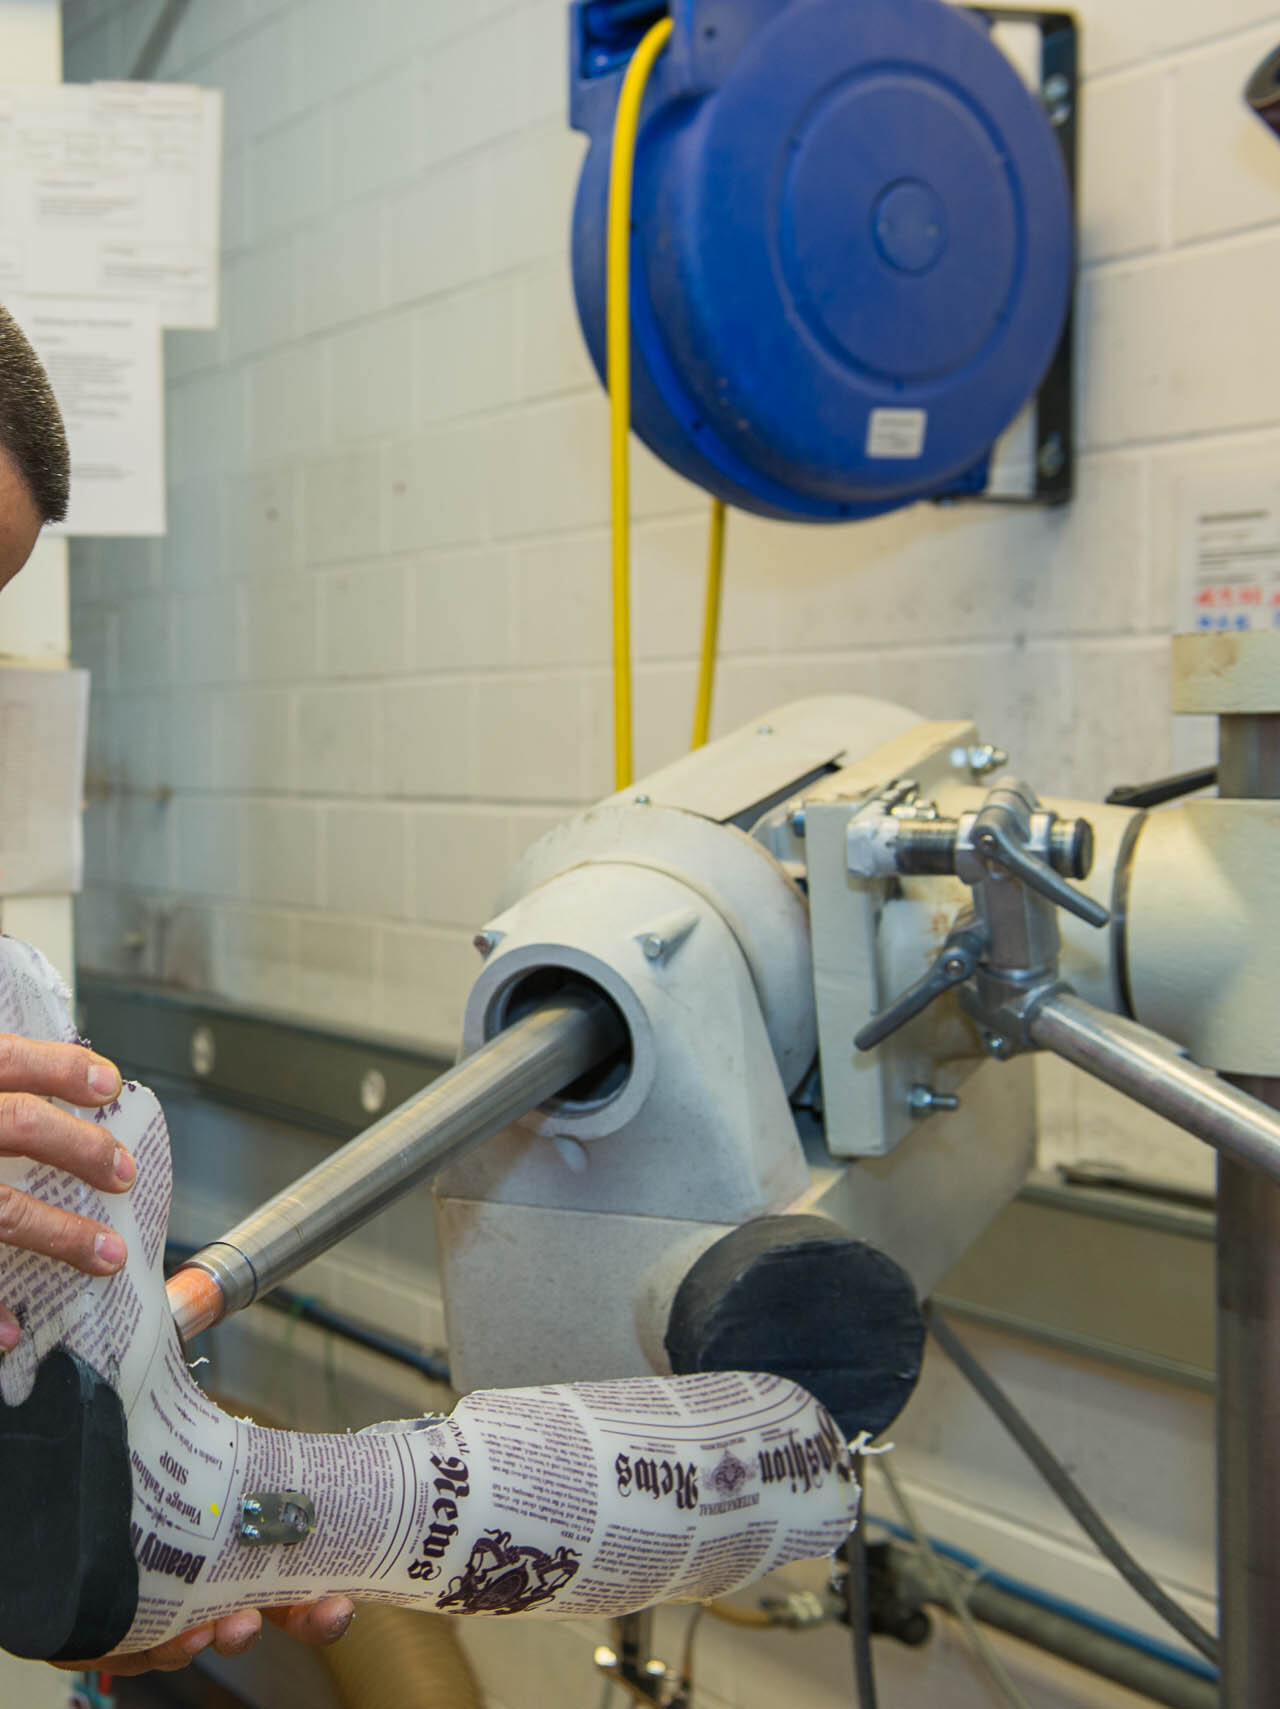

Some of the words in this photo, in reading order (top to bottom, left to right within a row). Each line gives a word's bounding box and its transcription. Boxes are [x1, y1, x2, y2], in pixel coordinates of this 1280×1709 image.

[446, 1418, 470, 1455] ONAL
[131, 1450, 165, 1504] Fashion
[159, 1451, 189, 1485] SHOP
[615, 1452, 699, 1509] News
[167, 1490, 202, 1525] Vintage
[407, 1451, 470, 1581] News
[138, 1531, 206, 1584] Beauty
